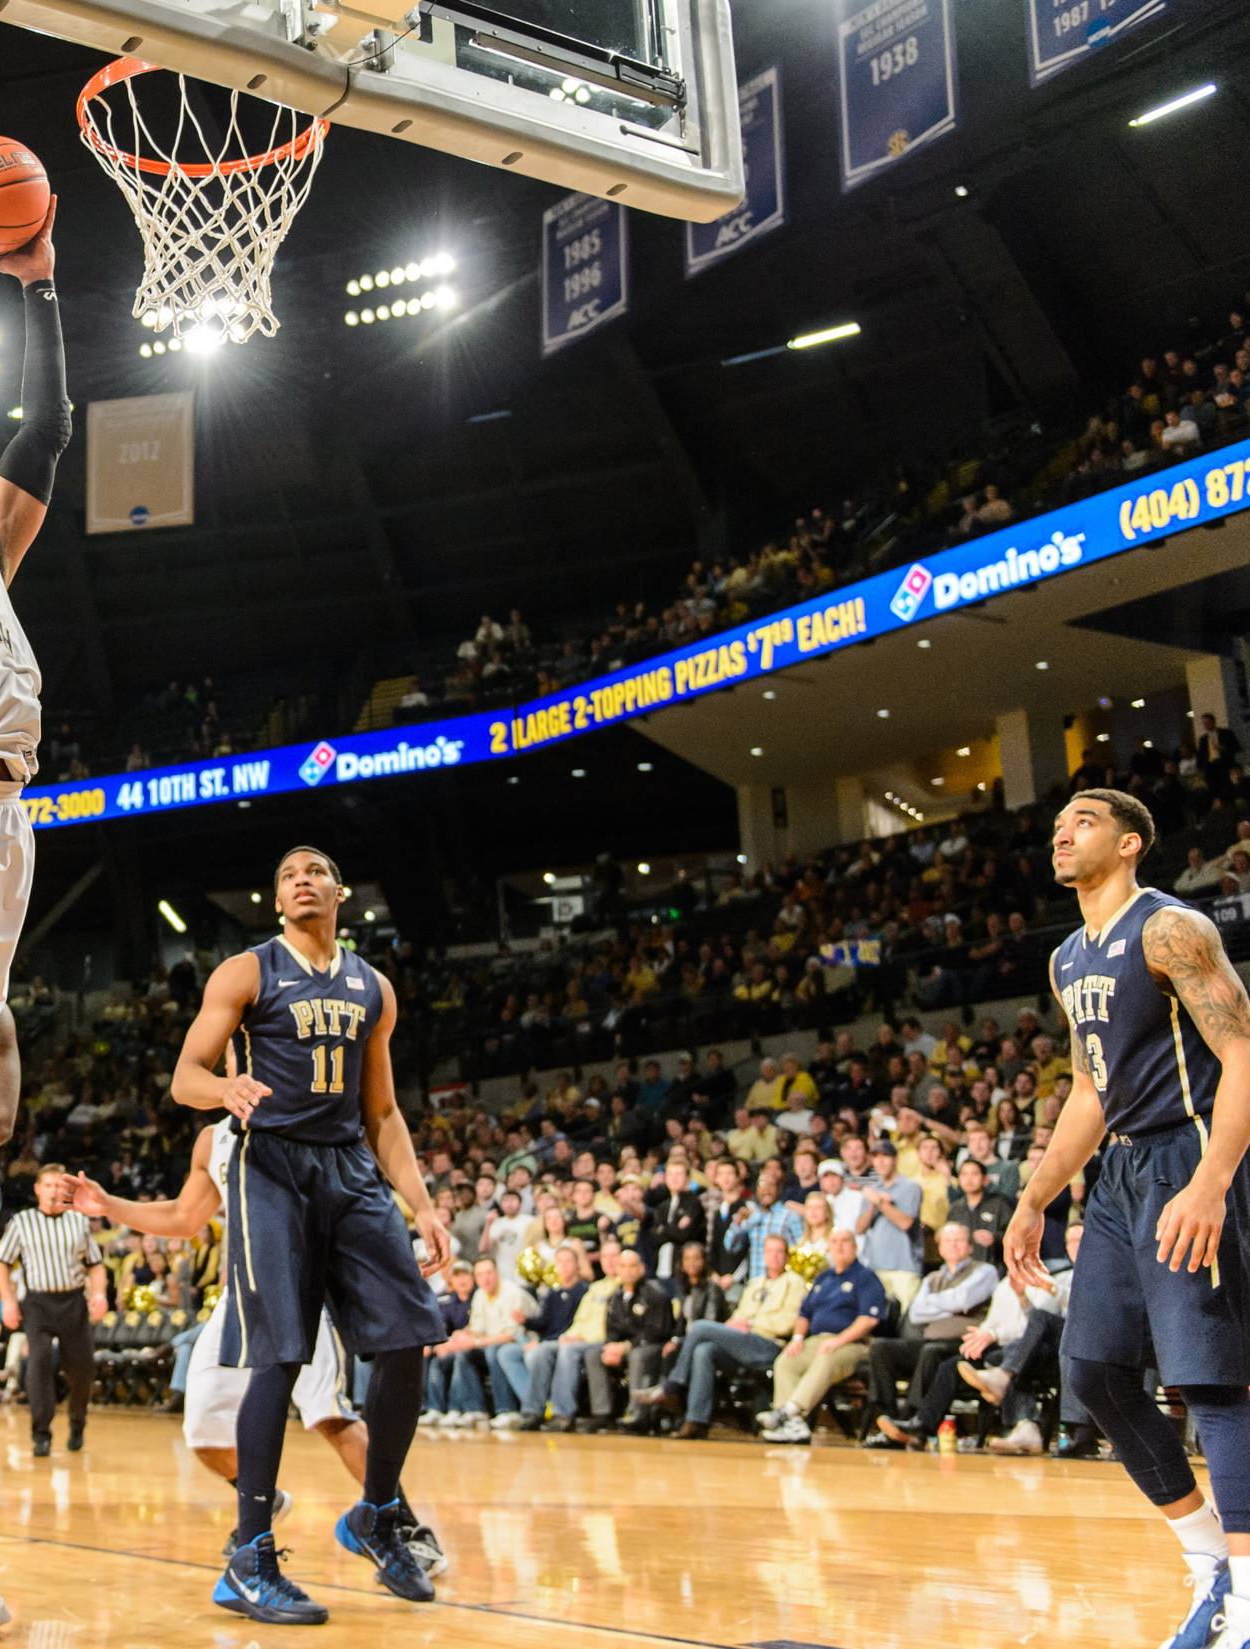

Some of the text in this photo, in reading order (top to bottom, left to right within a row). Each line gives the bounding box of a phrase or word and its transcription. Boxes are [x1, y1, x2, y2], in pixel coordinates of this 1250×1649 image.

[1053, 1, 1089, 37] 1987
[870, 36, 918, 86] 1938
[933, 531, 1085, 609] Domino's
[1119, 478, 1200, 540] (404)
[336, 736, 464, 782] Domino's
[489, 722, 508, 754] 2
[511, 701, 572, 750] LARGE
[572, 666, 673, 729] 2-TOPPING
[674, 640, 748, 694] PIZZAS
[796, 596, 867, 652] EACH!
[116, 781, 144, 811] 44
[147, 772, 196, 806] 10TH
[199, 767, 229, 799] ST.
[232, 760, 270, 793] NW
[289, 998, 367, 1041] PITT
[1061, 975, 1116, 1031] PITT
[311, 1044, 344, 1094] 11
[1086, 1033, 1108, 1092] 3
